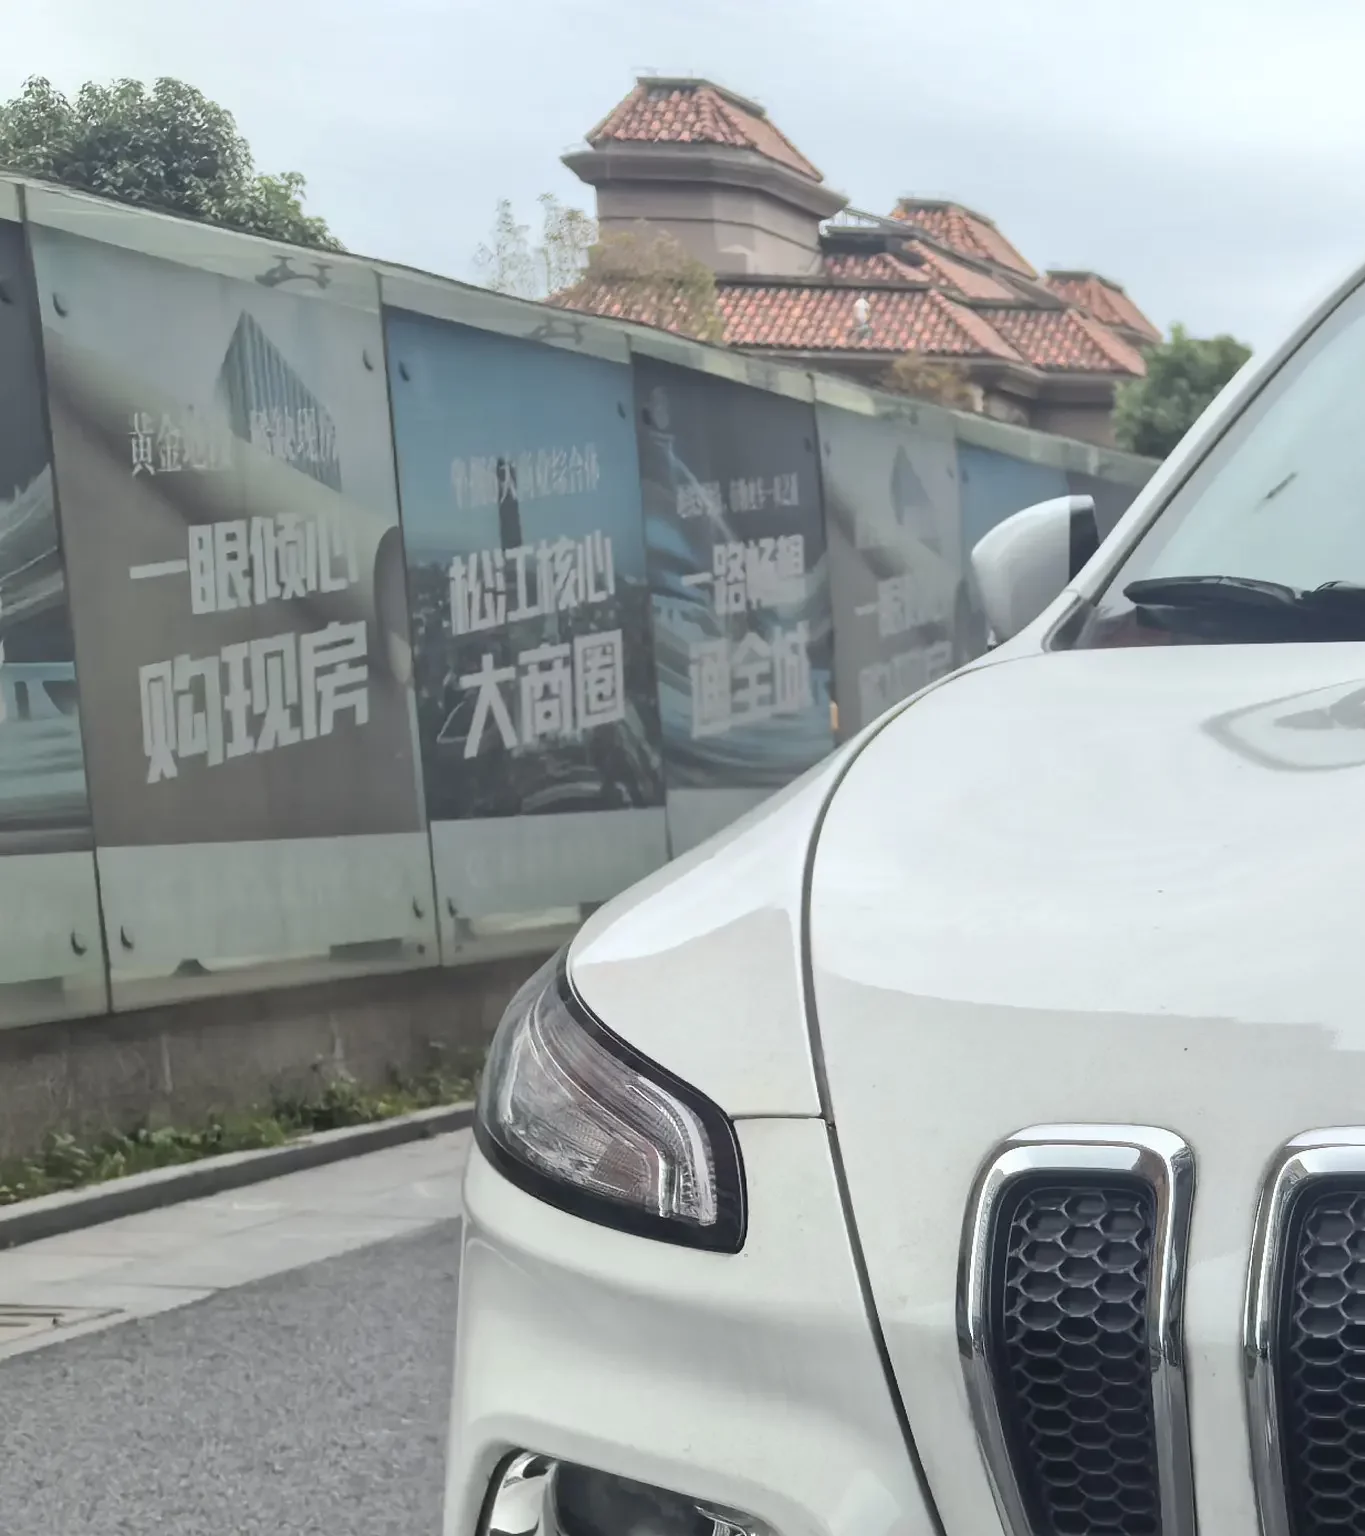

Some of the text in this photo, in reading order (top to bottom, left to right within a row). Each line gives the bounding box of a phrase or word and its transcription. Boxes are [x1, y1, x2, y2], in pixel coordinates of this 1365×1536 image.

[129, 511, 360, 616] 一眼倾心
[447, 530, 616, 637] 松江核心
[138, 620, 370, 785] 购现房
[459, 629, 625, 760] 大商圈
